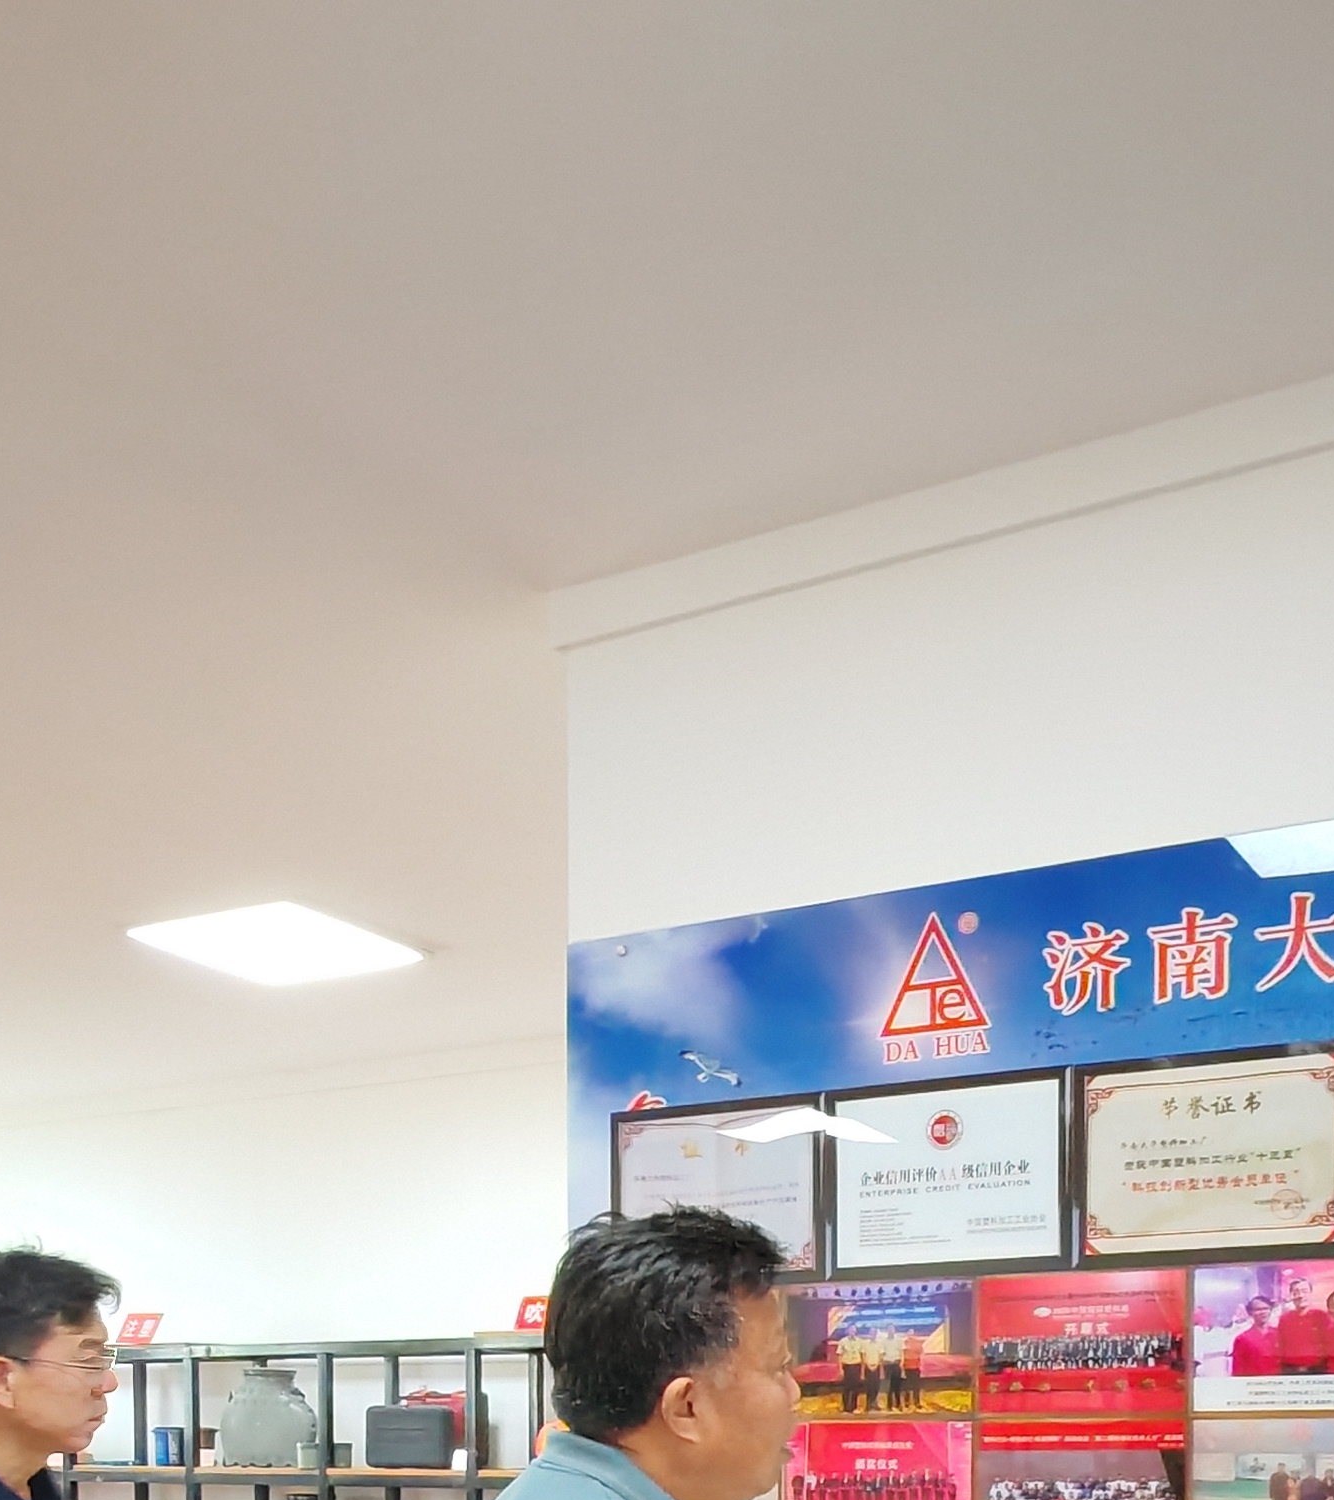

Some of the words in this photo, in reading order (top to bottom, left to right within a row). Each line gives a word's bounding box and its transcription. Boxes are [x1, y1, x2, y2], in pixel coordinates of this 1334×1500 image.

[884, 1039, 921, 1064] DA
[933, 1030, 990, 1059] HUA
[1161, 1090, 1263, 1120] 荣誉证书
[859, 1186, 919, 1199] ENTERPRISE
[925, 1183, 961, 1194] CREDIT
[967, 1178, 1031, 1190] EVALUATION
